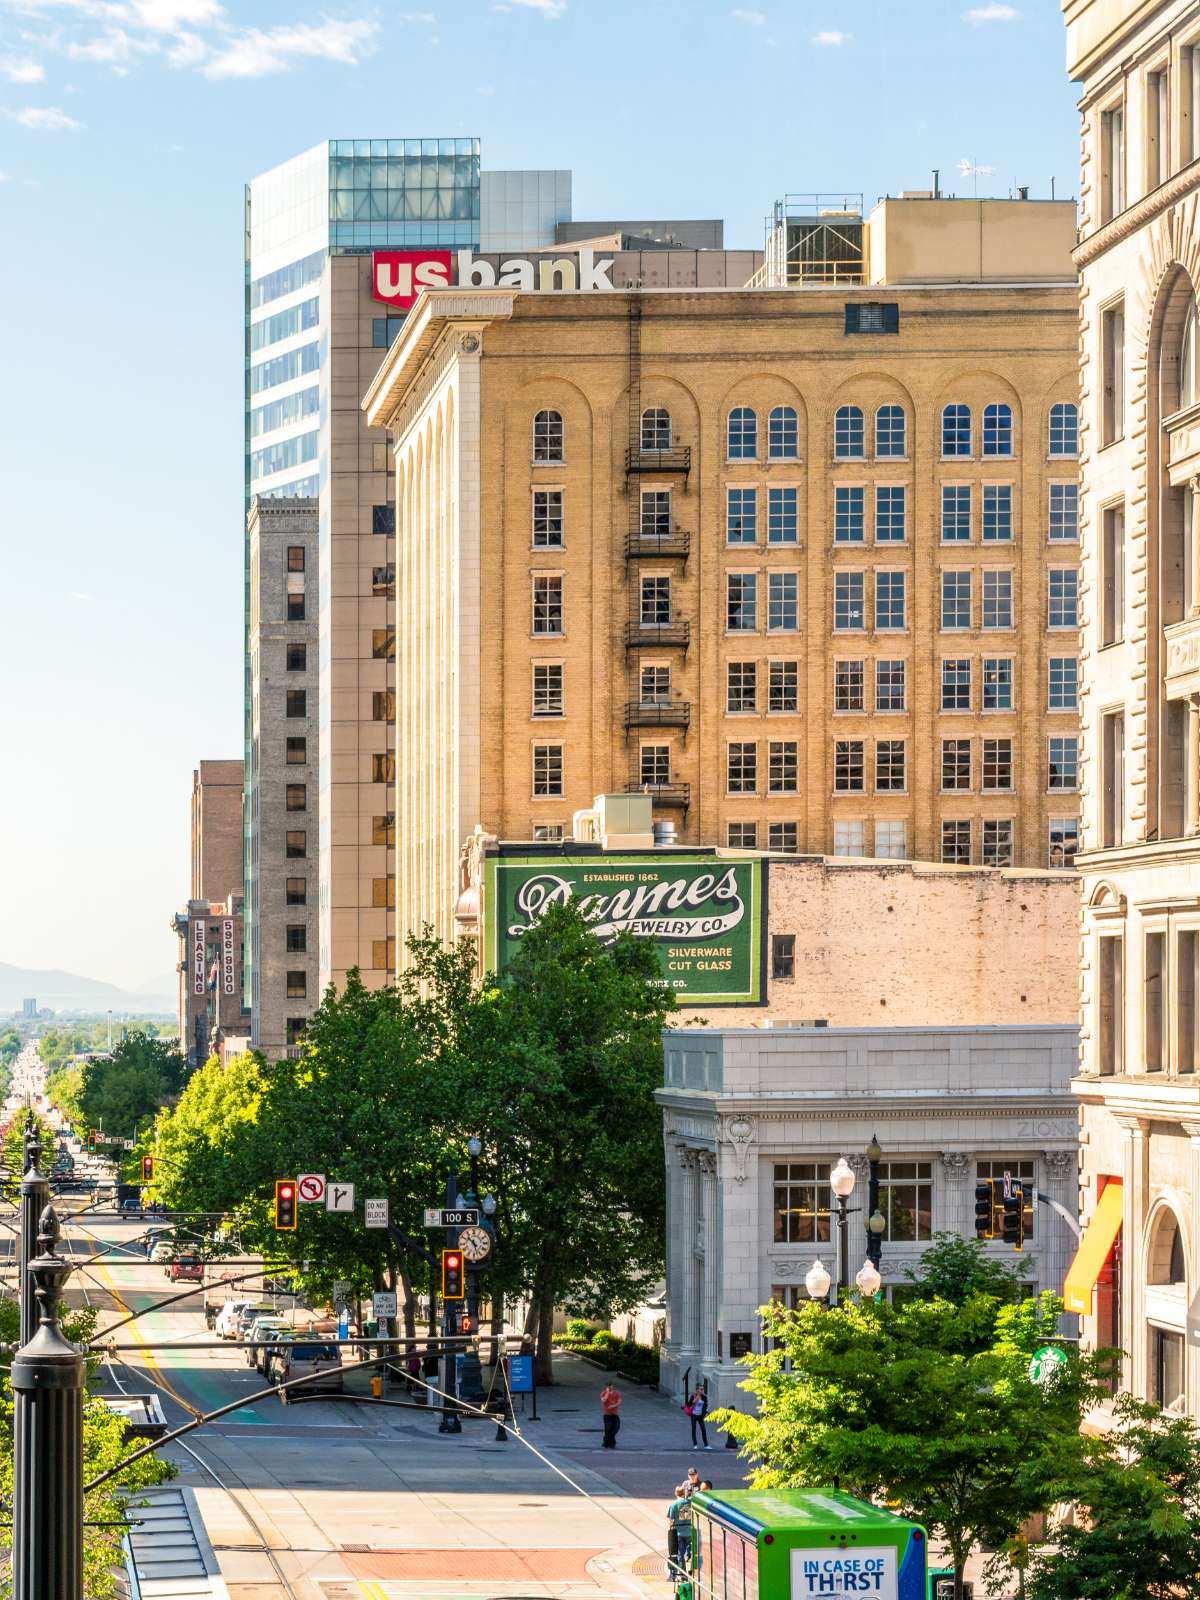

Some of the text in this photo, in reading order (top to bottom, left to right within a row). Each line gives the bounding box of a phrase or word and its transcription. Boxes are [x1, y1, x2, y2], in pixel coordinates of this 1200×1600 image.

[583, 873, 659, 882] ESTABLISHED 1862
[624, 918, 727, 935] JEWELRY CO.
[196, 922, 204, 993] LEASING
[224, 921, 233, 993] 596-9900
[667, 947, 733, 958] SILVERWARE
[668, 960, 733, 970] CUT GLASS
[673, 980, 688, 988] CO.
[1016, 1120, 1075, 1137] ZIONS
[445, 1213, 462, 1223] 100
[804, 1559, 885, 1573] IN CASE OF
